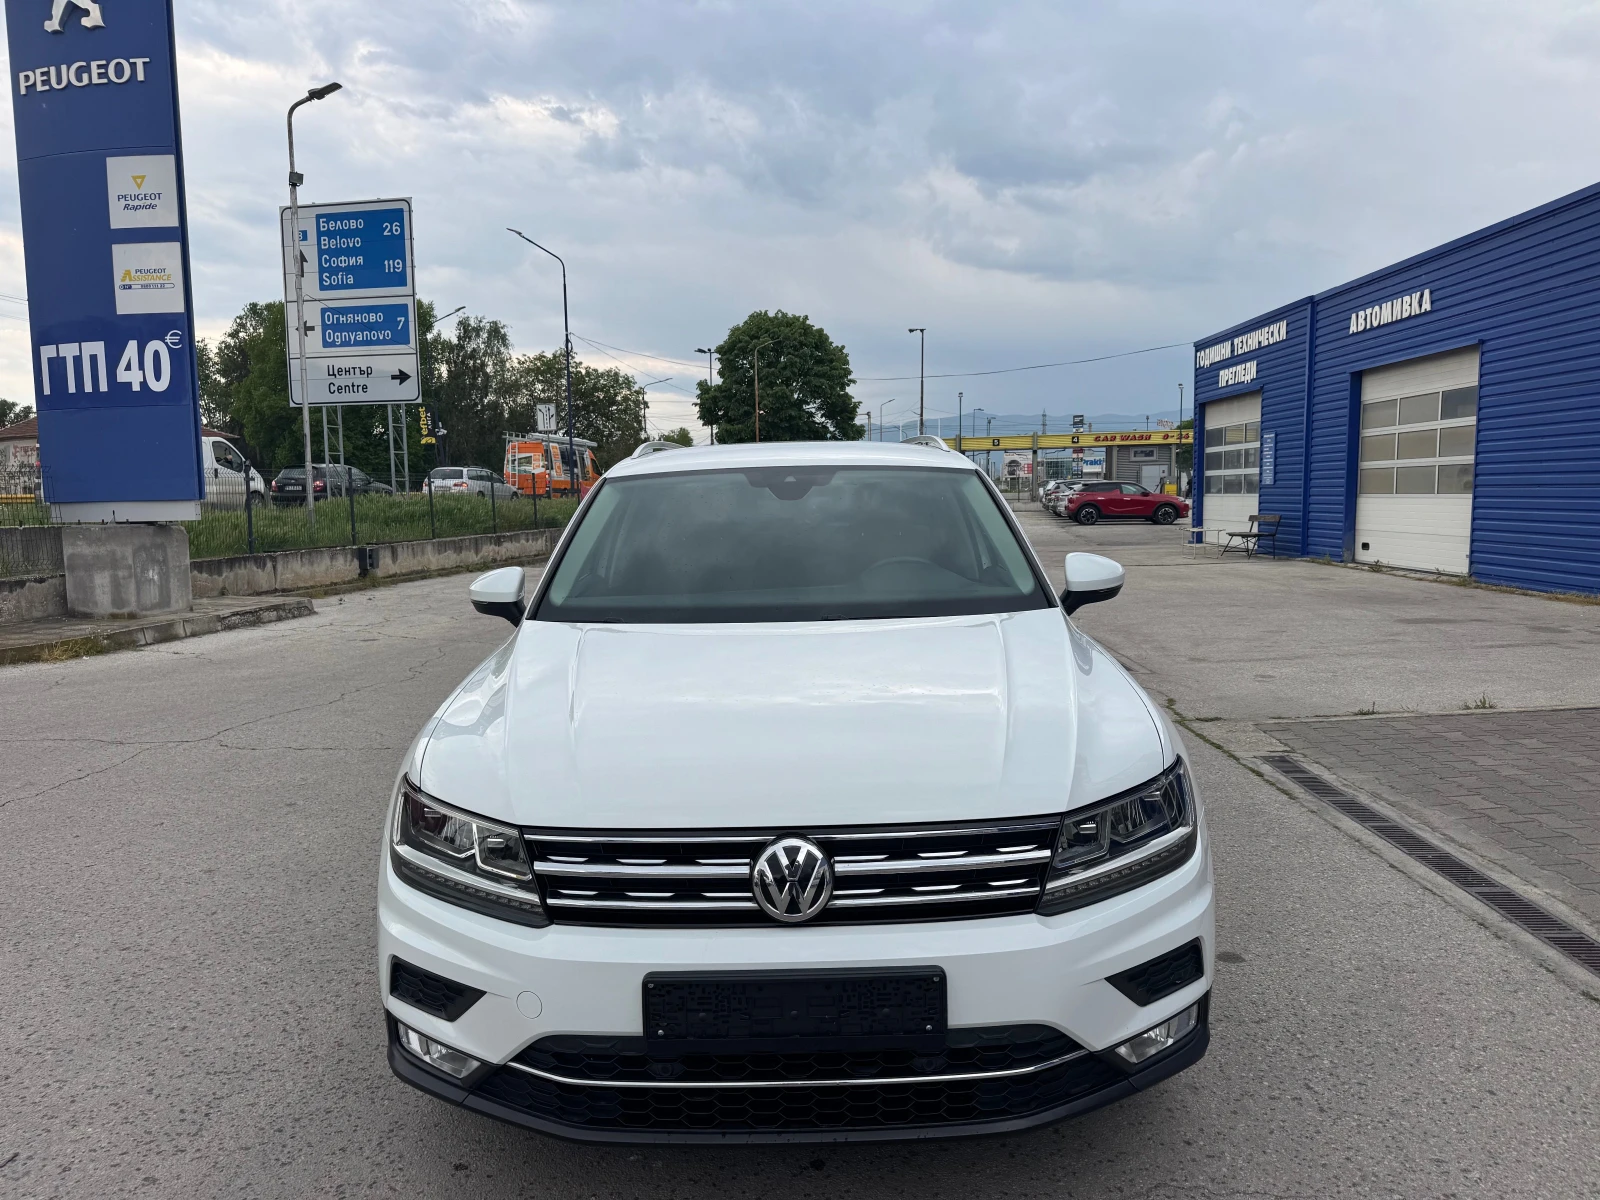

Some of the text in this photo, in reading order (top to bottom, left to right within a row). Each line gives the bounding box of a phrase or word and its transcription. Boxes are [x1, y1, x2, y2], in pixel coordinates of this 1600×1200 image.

[19, 57, 150, 95] PEUGEOT
[117, 192, 163, 202] PEUGEOT
[123, 202, 158, 212] Rapide
[320, 217, 401, 236] Белово 26
[321, 236, 361, 249] Belovo
[321, 254, 403, 273] София 119
[322, 272, 354, 286] Sofia
[1349, 288, 1431, 334] АВТОМИВКА
[325, 311, 405, 330] Огняново 7
[325, 329, 392, 345] Ognyanovo
[1196, 319, 1287, 368] ГОДИШНИ ТЕХНИЧЕСКИ
[39, 340, 109, 396] ГТП
[327, 364, 373, 378] Център
[1218, 360, 1257, 388] ПРЕГЛЕДИ
[328, 382, 368, 395] Centre
[1119, 433, 1152, 441] WASH
